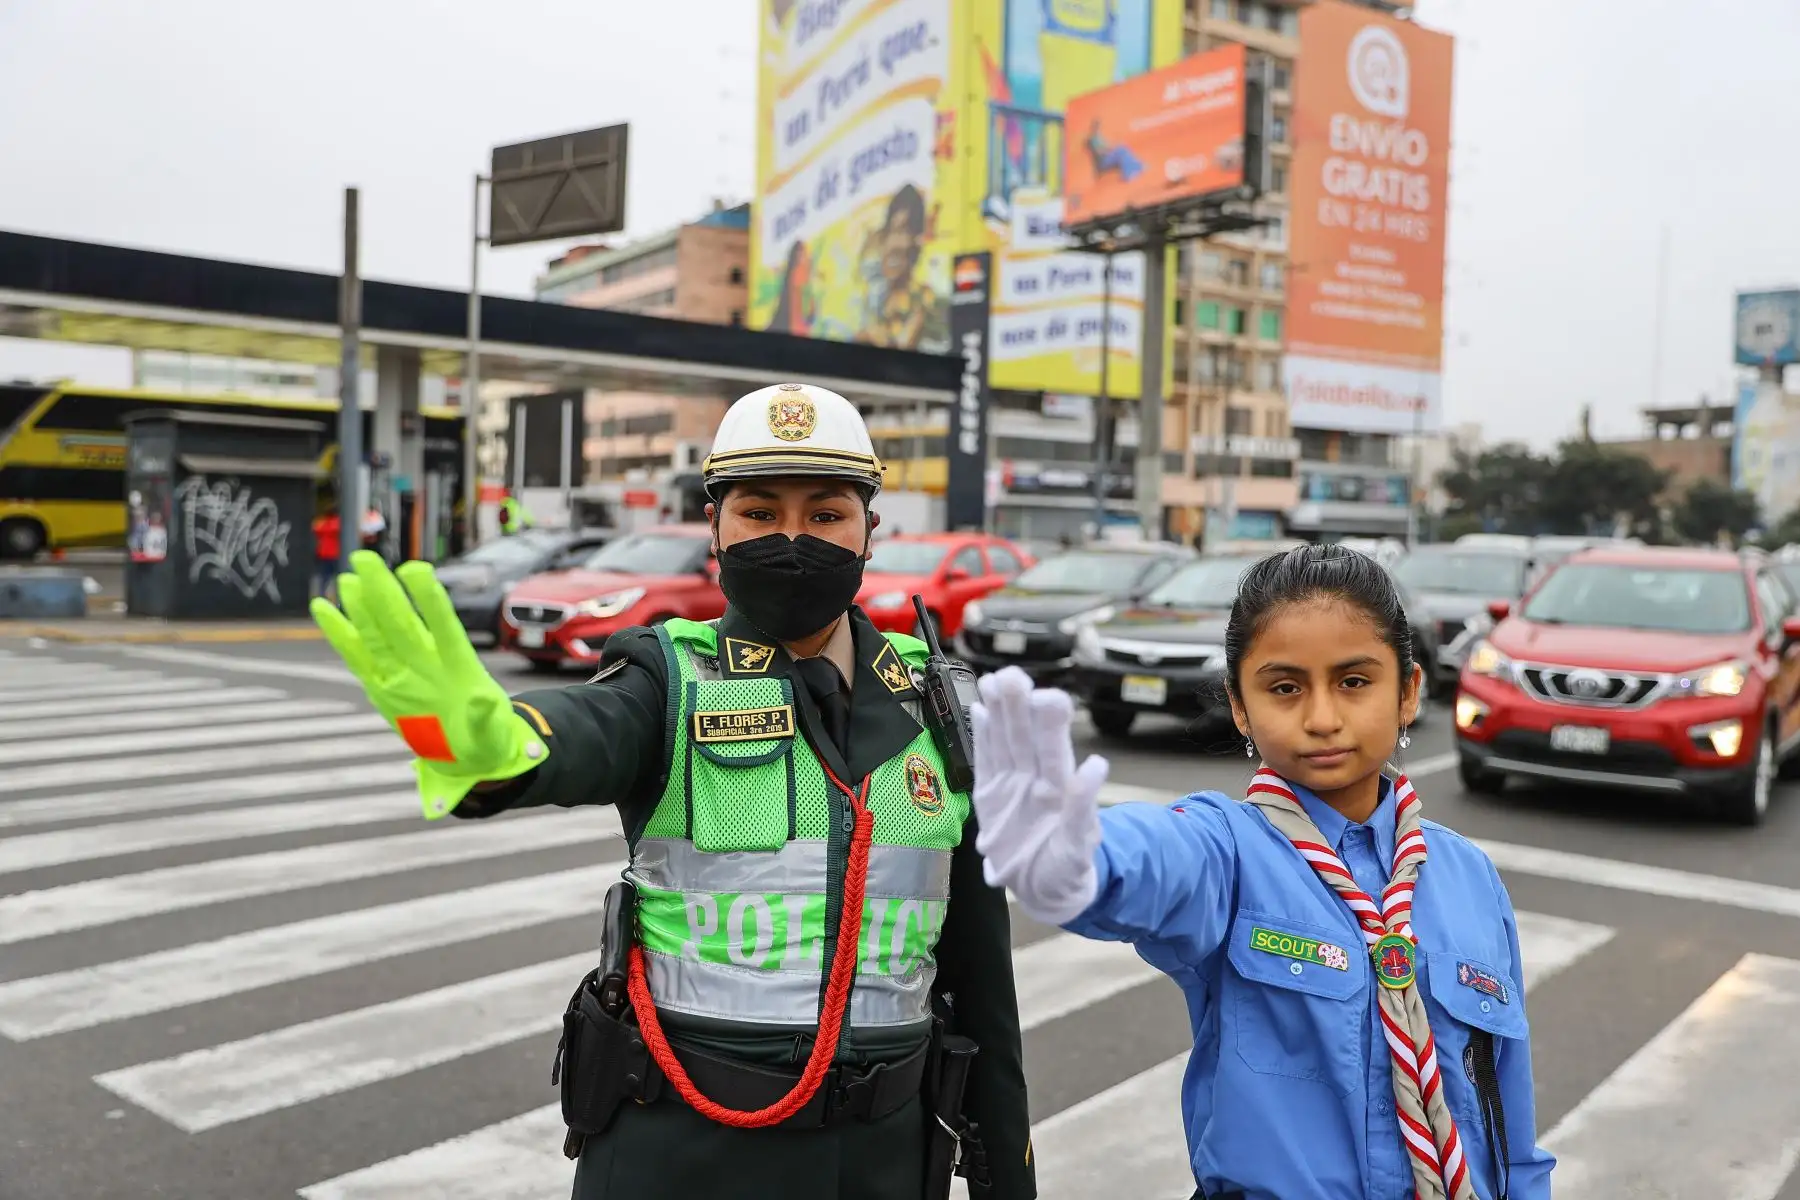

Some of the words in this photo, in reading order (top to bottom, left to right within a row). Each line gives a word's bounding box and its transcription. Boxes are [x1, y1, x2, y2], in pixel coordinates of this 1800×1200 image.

[847, 123, 920, 198] gusto
[1321, 156, 1430, 212] GRATIS
[1317, 198, 1352, 227] EN
[1353, 203, 1384, 233] 24
[1384, 211, 1430, 242] HRS
[1075, 315, 1128, 343] guto
[703, 716, 714, 729] E.
[720, 713, 767, 728] FLORES
[771, 712, 785, 724] P.
[706, 727, 747, 737] SUBOFICIAL
[1256, 932, 1317, 959] SCOUT
